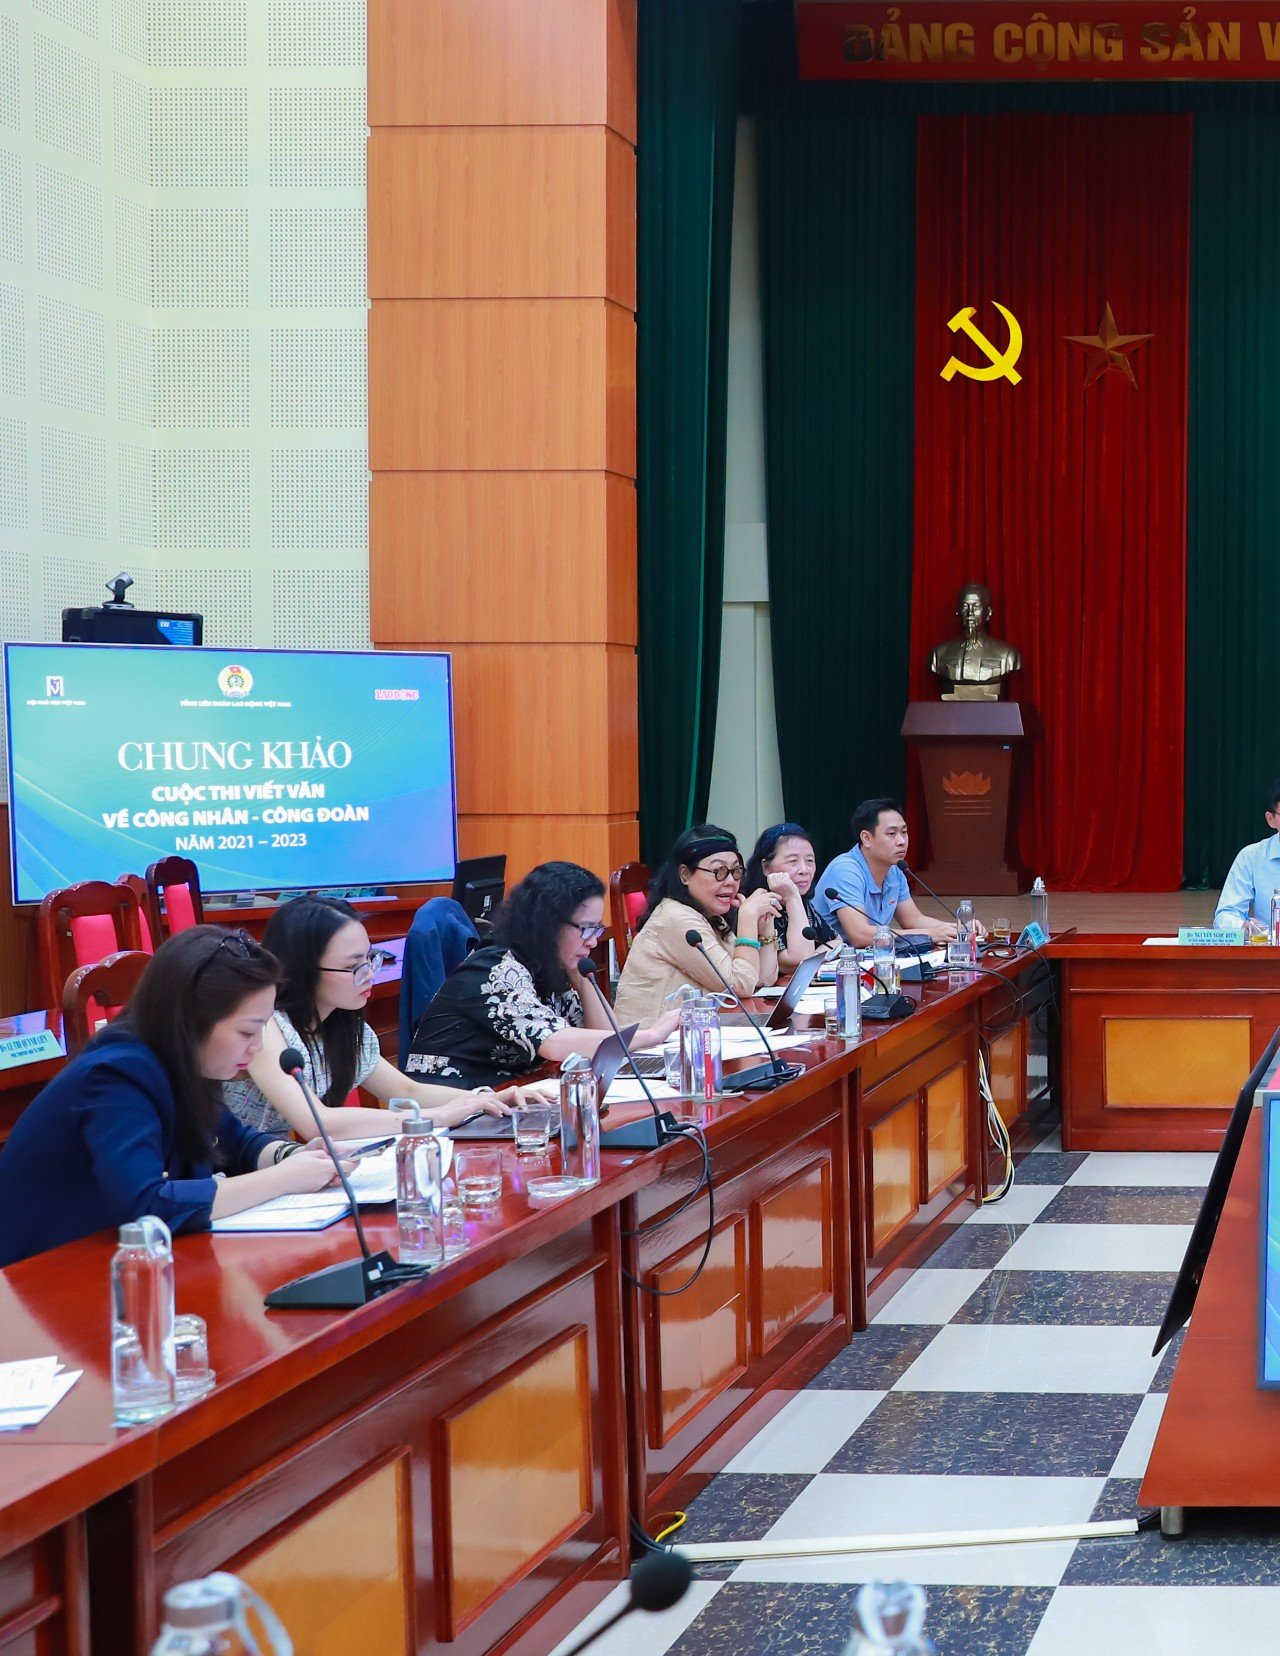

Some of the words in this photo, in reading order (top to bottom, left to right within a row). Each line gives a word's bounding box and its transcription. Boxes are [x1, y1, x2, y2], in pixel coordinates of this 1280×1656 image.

[842, 7, 975, 63] ĐẢNG
[993, 12, 1124, 70] CỘNG
[1140, 6, 1242, 63] SẢN
[118, 741, 252, 771] CHUNG
[262, 736, 352, 769] KHẢO
[151, 783, 208, 805] CUỘC
[208, 785, 241, 801] THI
[242, 780, 285, 800] VIẾT
[285, 781, 325, 799] VĂN
[102, 808, 130, 829] VỀ
[132, 808, 190, 828] CÔNG
[192, 807, 249, 826] NHÂN
[261, 806, 314, 824] CÔNG
[316, 804, 369, 823] ĐOÀN
[175, 834, 214, 851] NĂM
[217, 835, 254, 850] 2021
[270, 833, 307, 848] 2023
